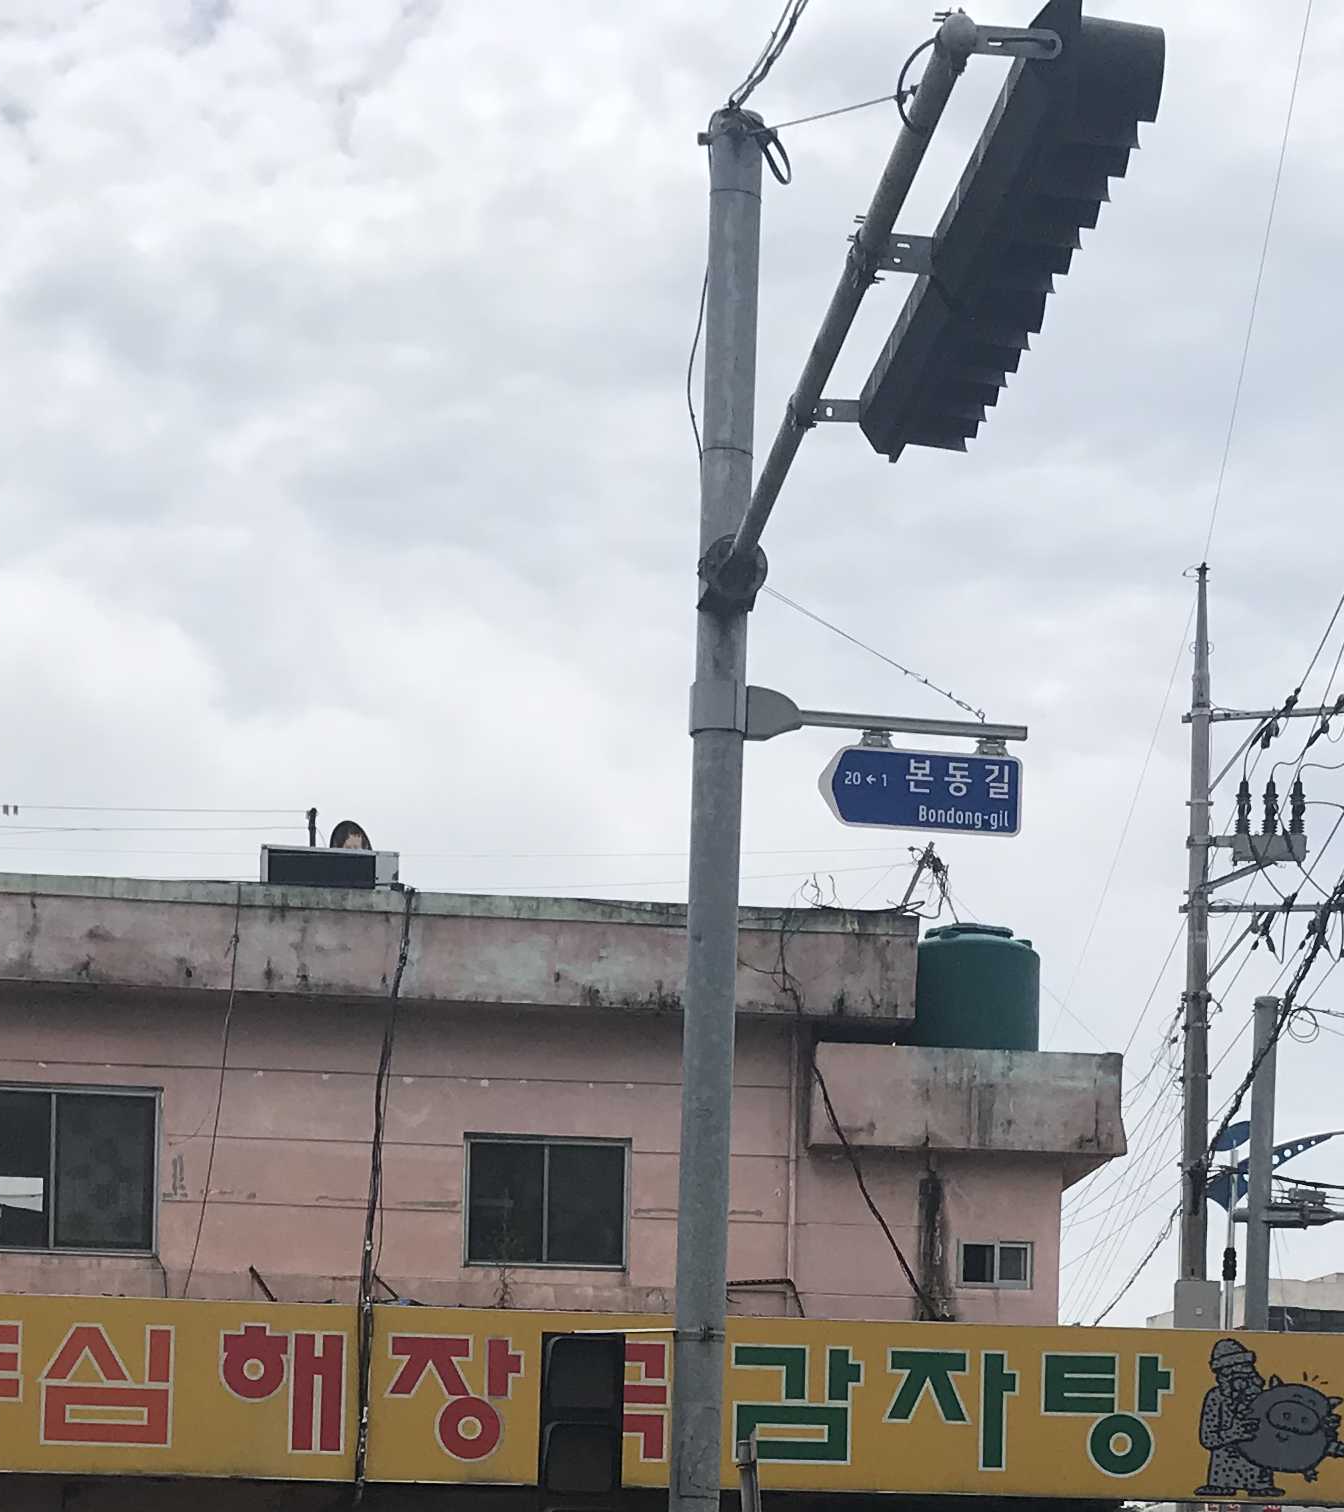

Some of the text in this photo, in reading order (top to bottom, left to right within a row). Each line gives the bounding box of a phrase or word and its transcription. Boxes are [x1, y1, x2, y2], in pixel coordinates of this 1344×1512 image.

[844, 758, 1010, 800] 20 1 본동길
[918, 804, 1010, 830] Bondong-gil
[730, 1342, 1176, 1479] 감자탕
